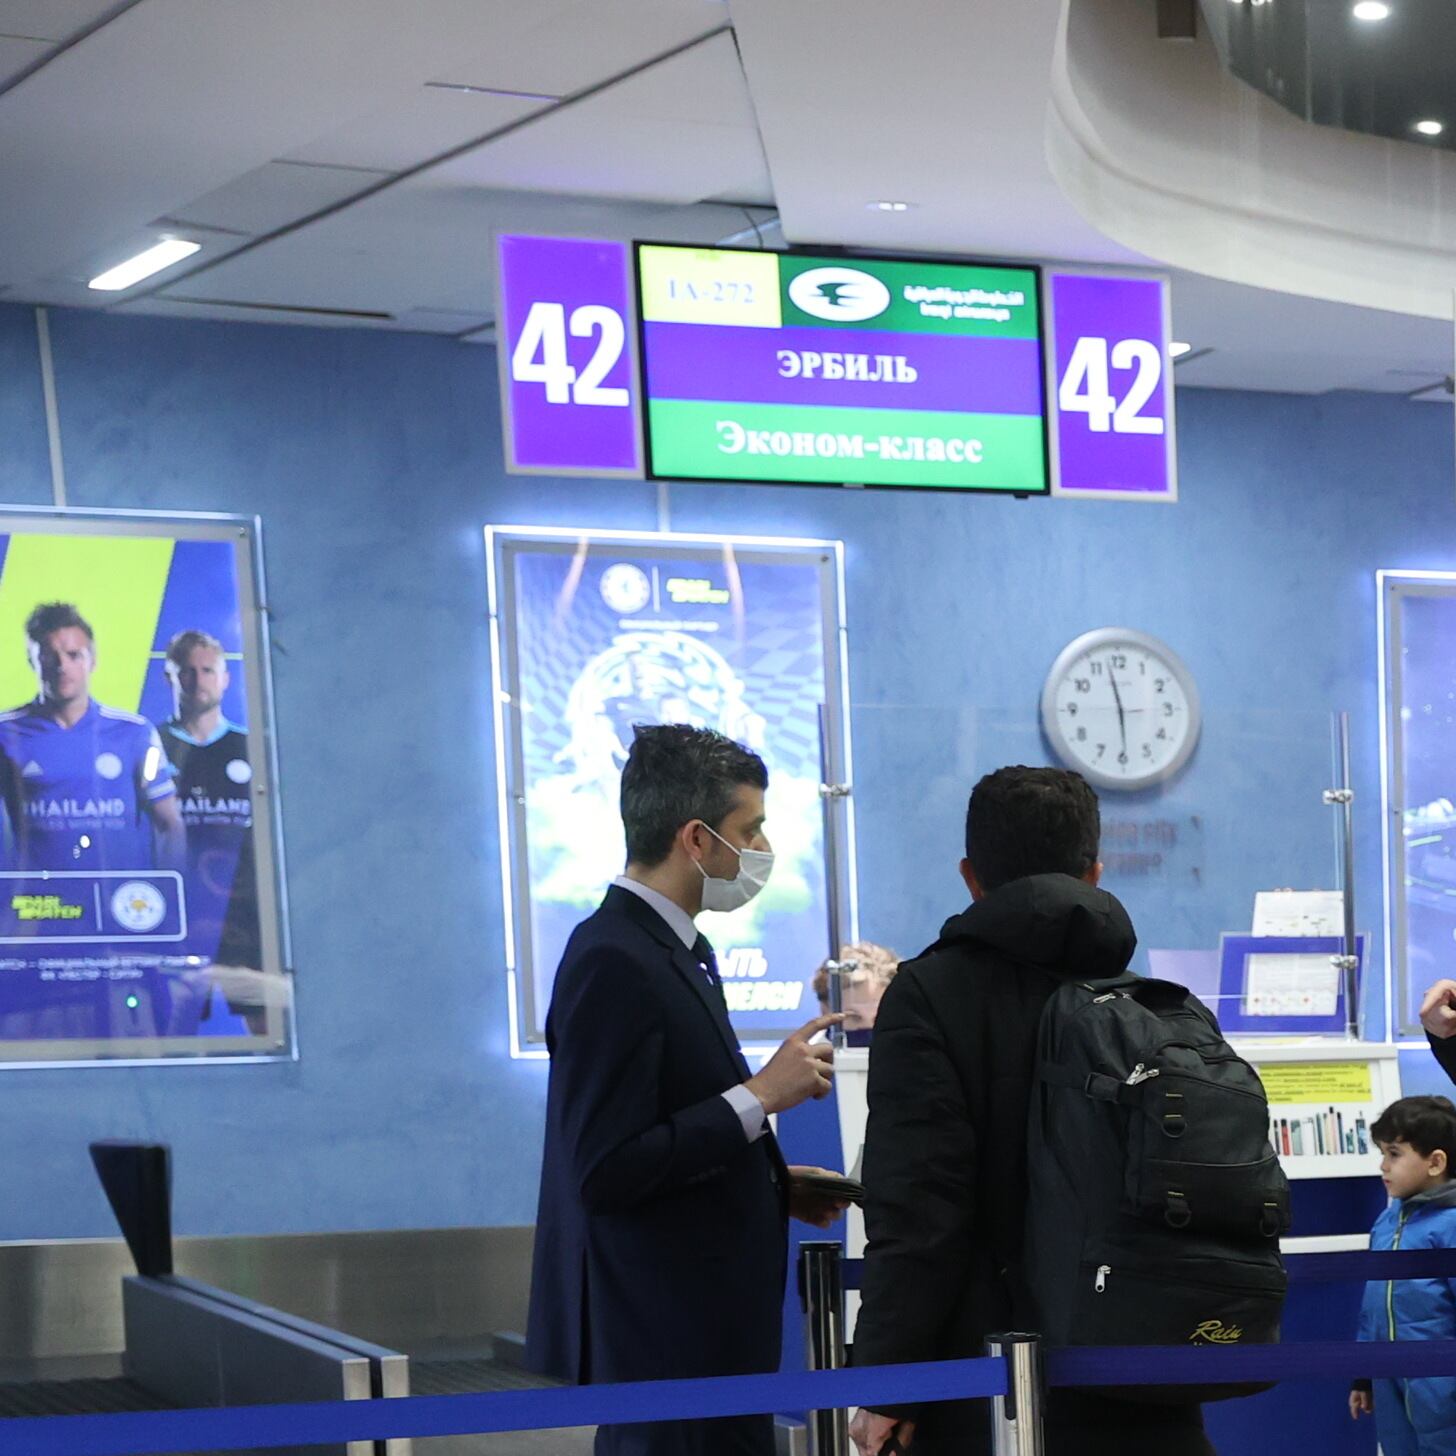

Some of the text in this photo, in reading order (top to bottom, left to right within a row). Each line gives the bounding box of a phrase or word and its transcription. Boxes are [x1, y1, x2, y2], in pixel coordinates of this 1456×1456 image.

[511, 302, 630, 407] 42
[776, 350, 918, 384] ЭРБИЛЬ
[1058, 336, 1164, 434] 42
[715, 420, 983, 464] Эконом-класс
[1090, 661, 1102, 675] 11
[1111, 654, 1127, 669] 12
[1139, 661, 1146, 676] 1
[1074, 678, 1091, 693] 10
[1154, 678, 1165, 693] 2
[1067, 702, 1078, 717] 9
[1163, 702, 1174, 717] 3
[1076, 726, 1087, 742] 8
[1155, 727, 1166, 740] 4
[1096, 743, 1106, 758] 7
[1117, 750, 1129, 765] 6
[1142, 743, 1152, 758] 5
